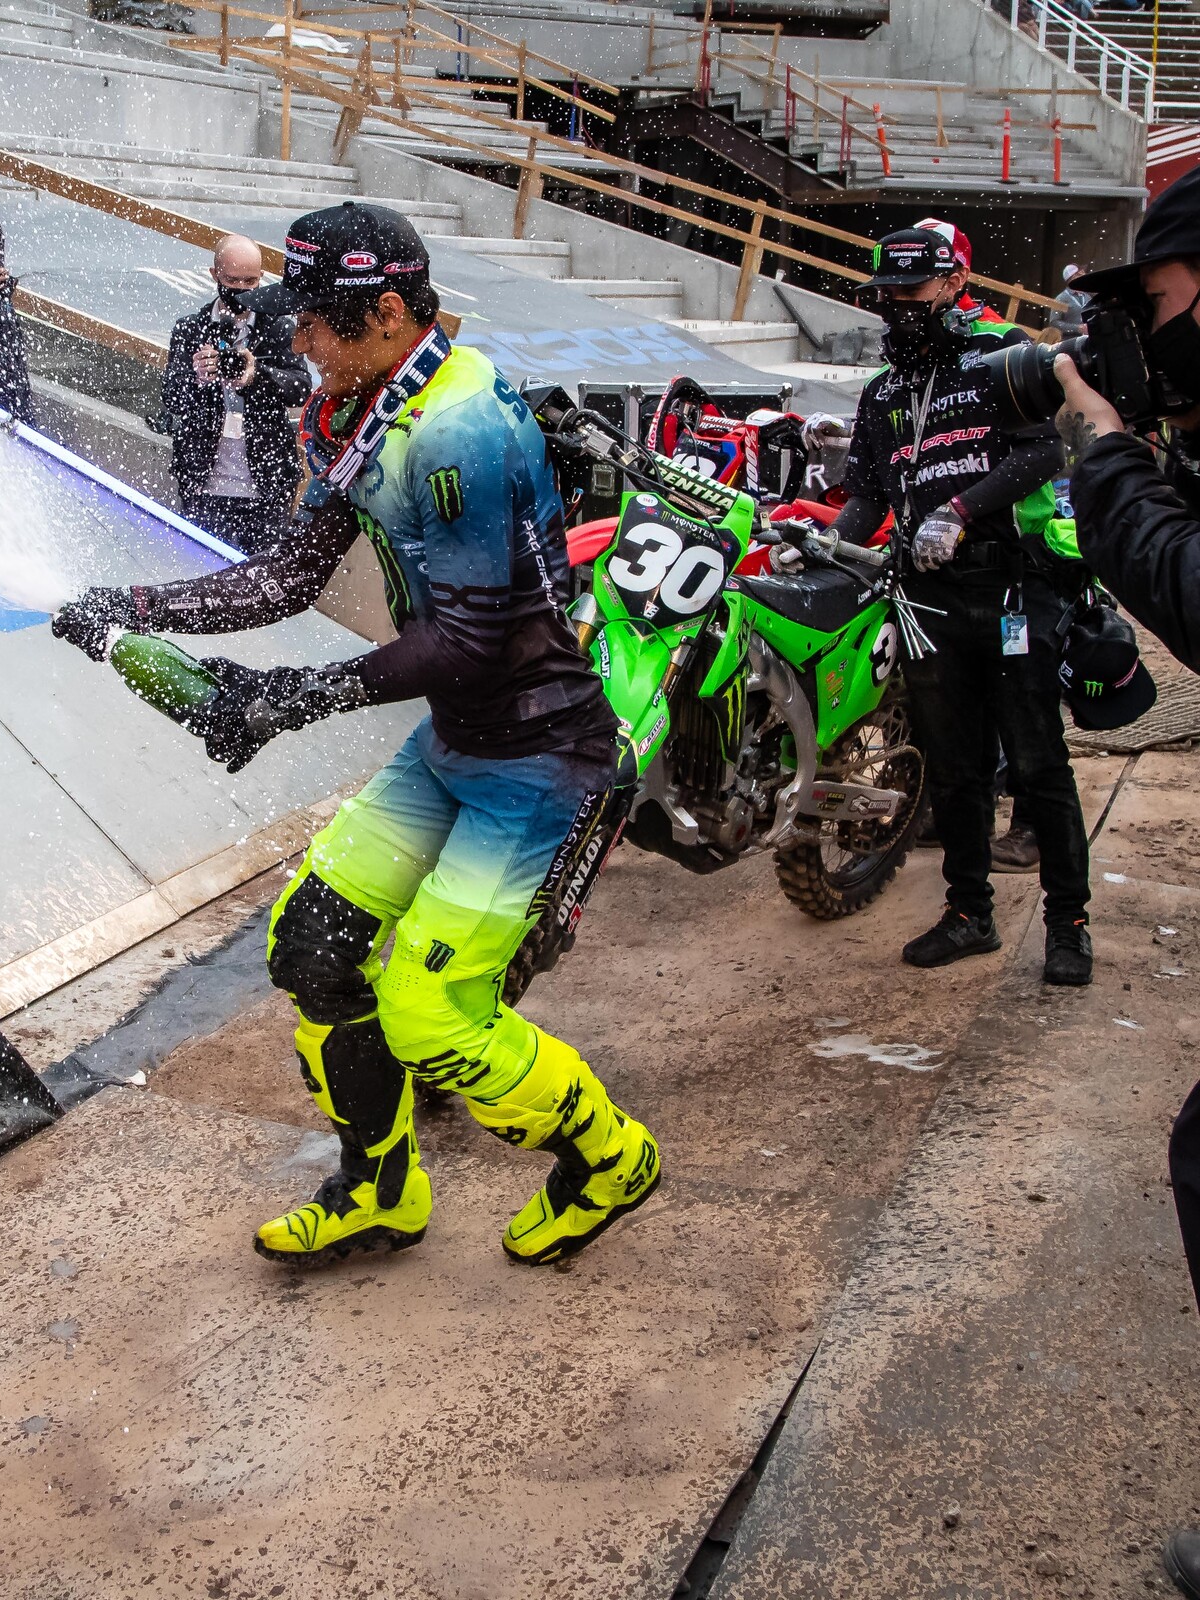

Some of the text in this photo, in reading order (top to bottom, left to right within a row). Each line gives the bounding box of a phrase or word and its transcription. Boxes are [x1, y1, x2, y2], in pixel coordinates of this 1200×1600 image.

[346, 256, 373, 266] BELL
[334, 276, 386, 286] DUNLOP
[960, 355, 983, 371] GREE
[328, 328, 447, 491] SCOTT
[905, 389, 981, 422] MNSTER
[921, 426, 992, 452] CIRCUIT
[745, 427, 759, 492] 100%
[521, 519, 541, 552] PRO
[670, 513, 716, 542] MONSTER
[608, 522, 725, 615] 30
[600, 641, 611, 679] CIRCUIT
[546, 793, 597, 889] MONSTER
